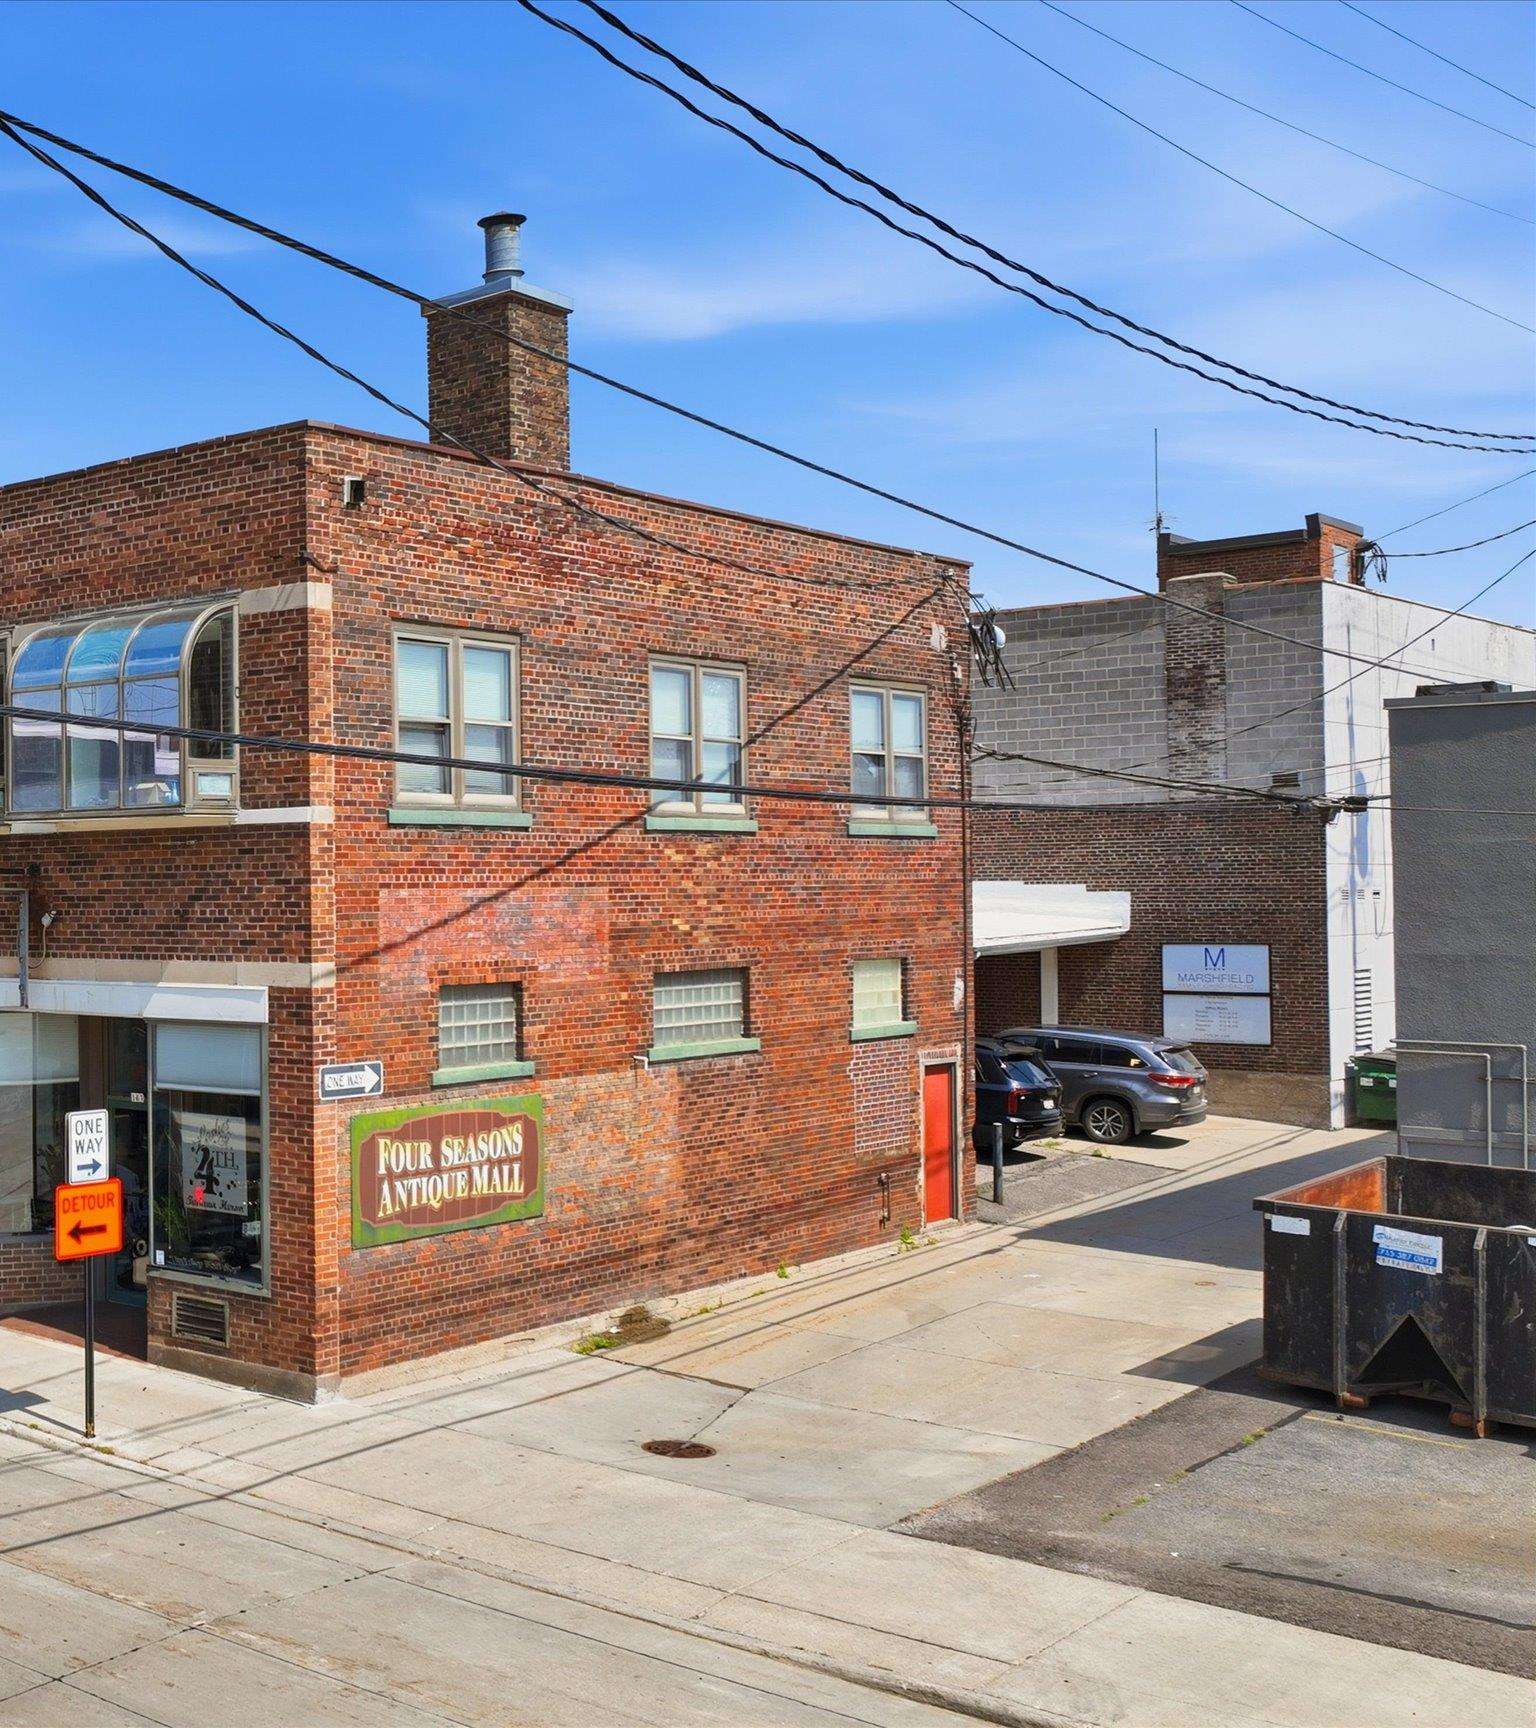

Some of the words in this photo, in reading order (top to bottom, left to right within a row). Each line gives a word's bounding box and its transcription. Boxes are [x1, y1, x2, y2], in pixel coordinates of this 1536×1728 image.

[1204, 947, 1225, 967] M
[1177, 973, 1254, 984] MARSHFIELD
[326, 1074, 345, 1089] ONE
[347, 1072, 364, 1087] WAY
[74, 1117, 103, 1136] ONE
[74, 1136, 103, 1155] WAY
[377, 1138, 434, 1175] FOUR
[441, 1123, 524, 1167] SEASONS
[377, 1168, 469, 1218] ANTIQUE
[472, 1164, 524, 1194] MALL
[62, 1191, 115, 1215] DETOUR
